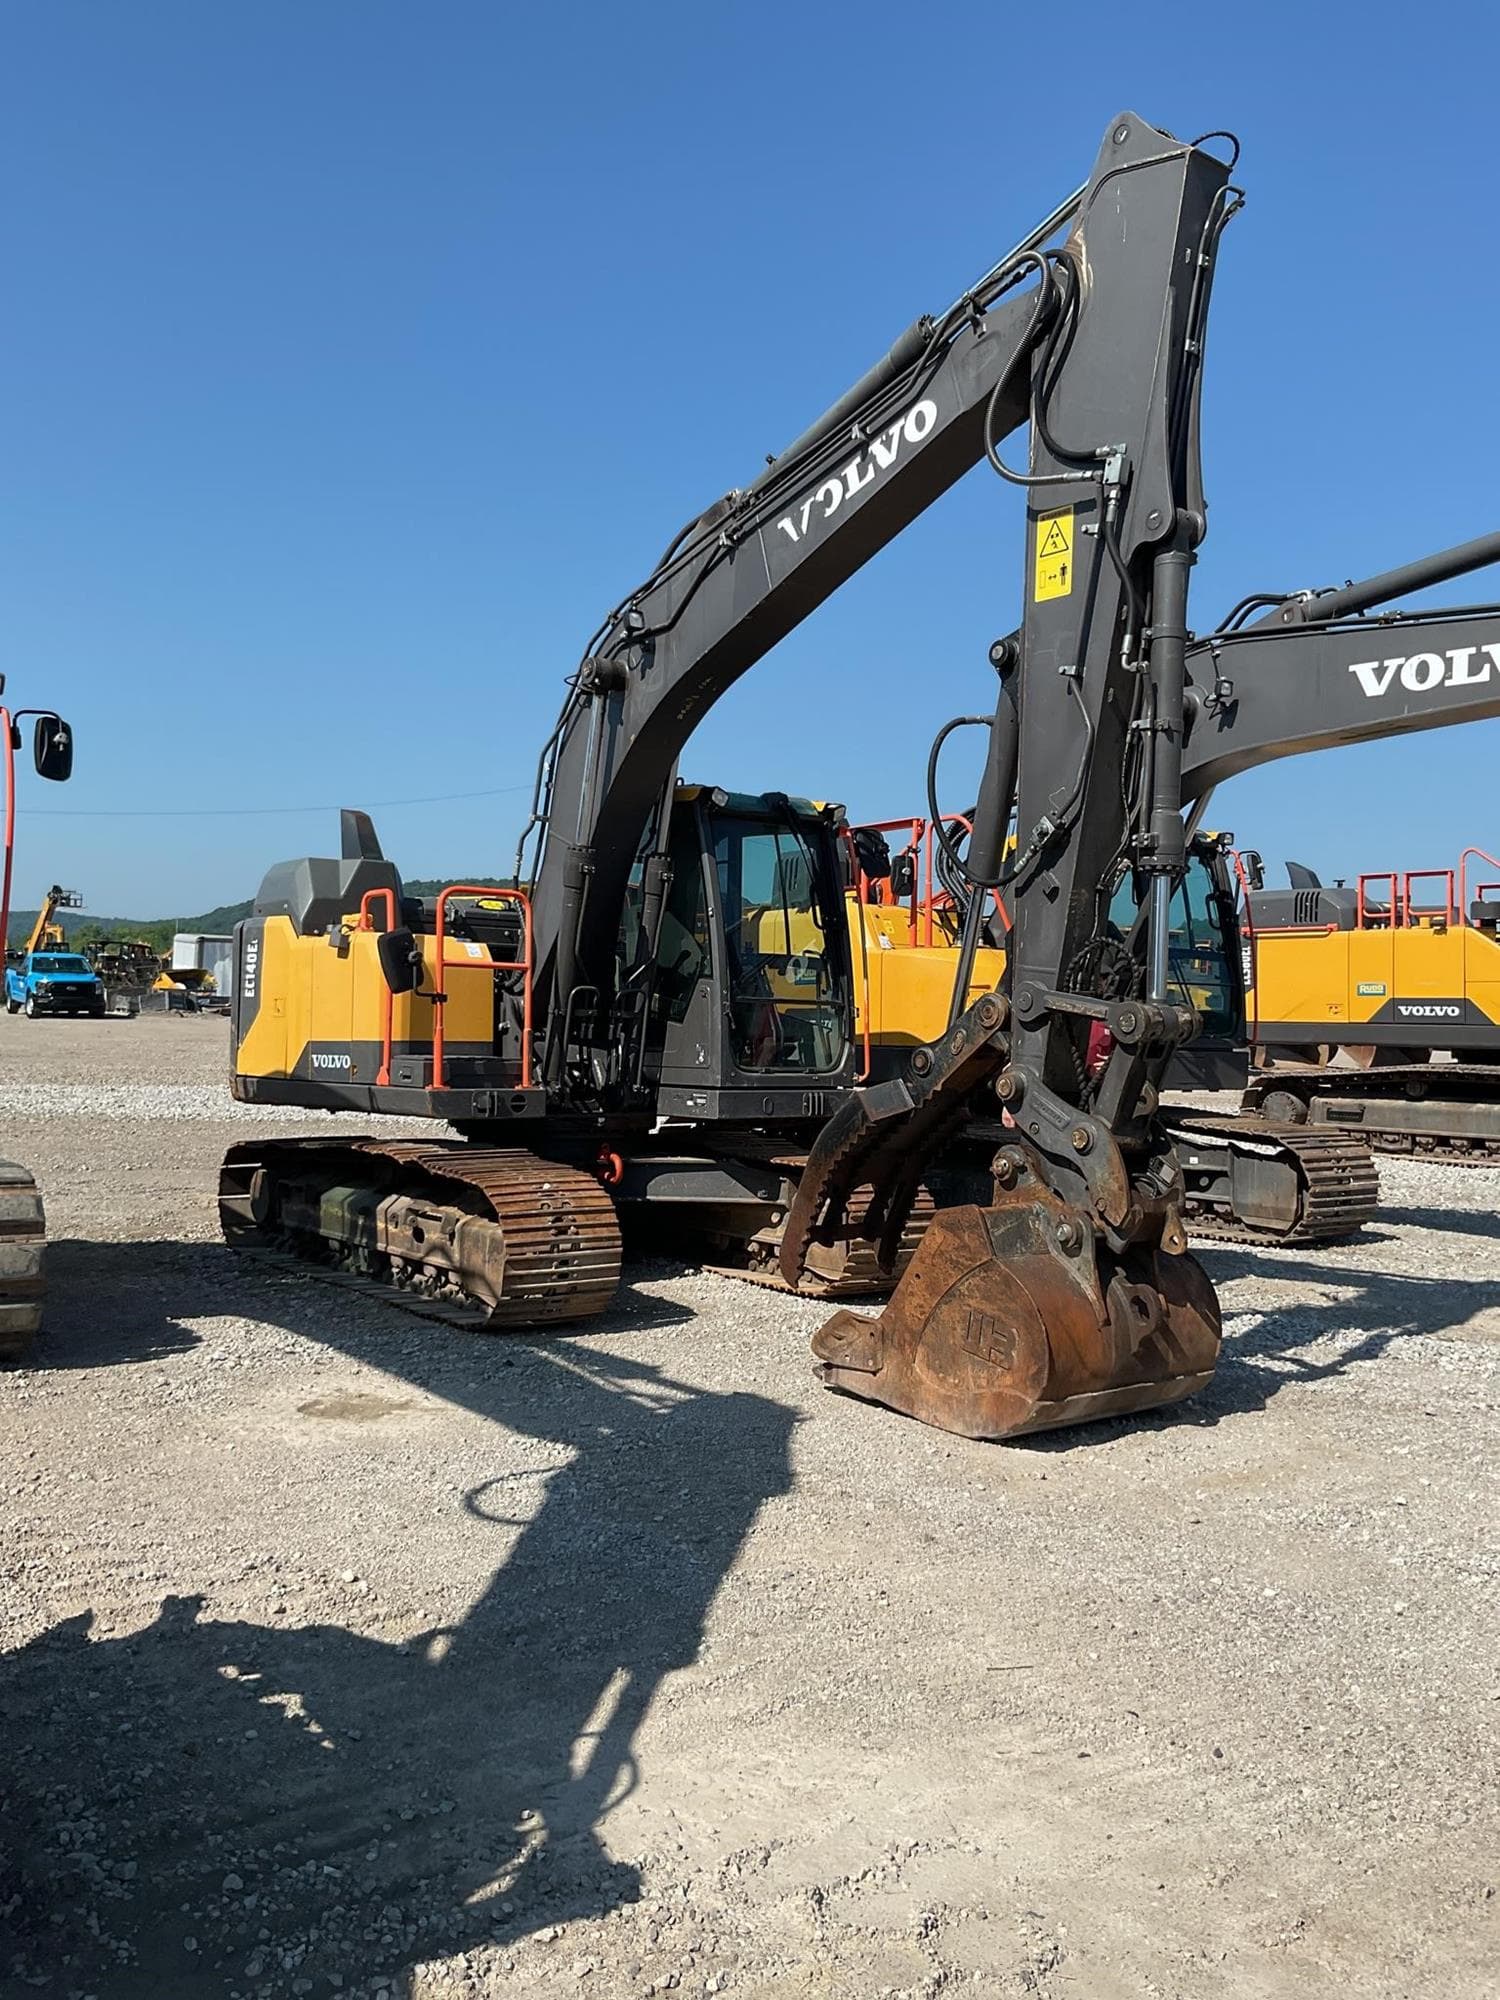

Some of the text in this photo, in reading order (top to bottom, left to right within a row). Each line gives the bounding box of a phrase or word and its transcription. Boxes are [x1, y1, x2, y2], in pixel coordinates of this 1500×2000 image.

[777, 399, 938, 542] VOLVO
[244, 939, 258, 998] EC140EL
[1398, 1005, 1460, 1017] VOLVO
[312, 1053, 351, 1069] VOLVO
